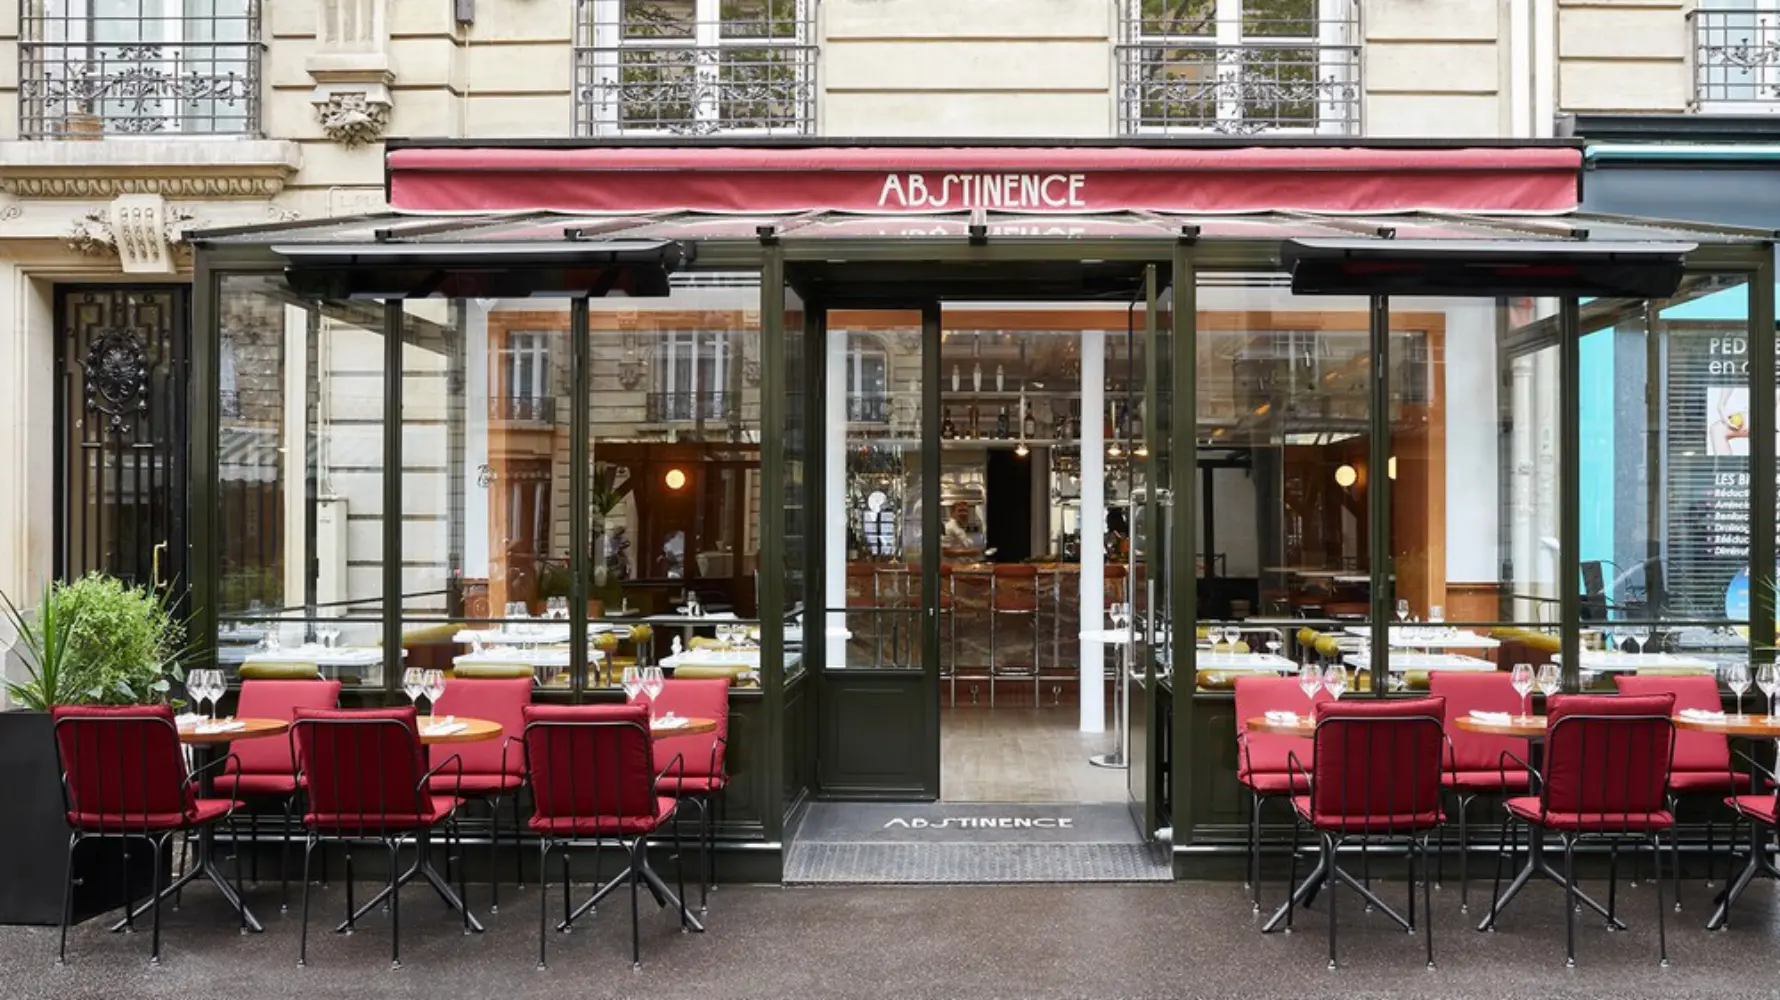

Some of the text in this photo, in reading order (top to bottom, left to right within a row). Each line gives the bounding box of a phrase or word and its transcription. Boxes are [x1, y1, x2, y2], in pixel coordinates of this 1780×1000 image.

[878, 174, 1085, 207] ABSTINENCE
[1710, 332, 1748, 355] PÉD
[1715, 473, 1735, 485] LES
[883, 818, 1073, 829] ABSTINENCE
